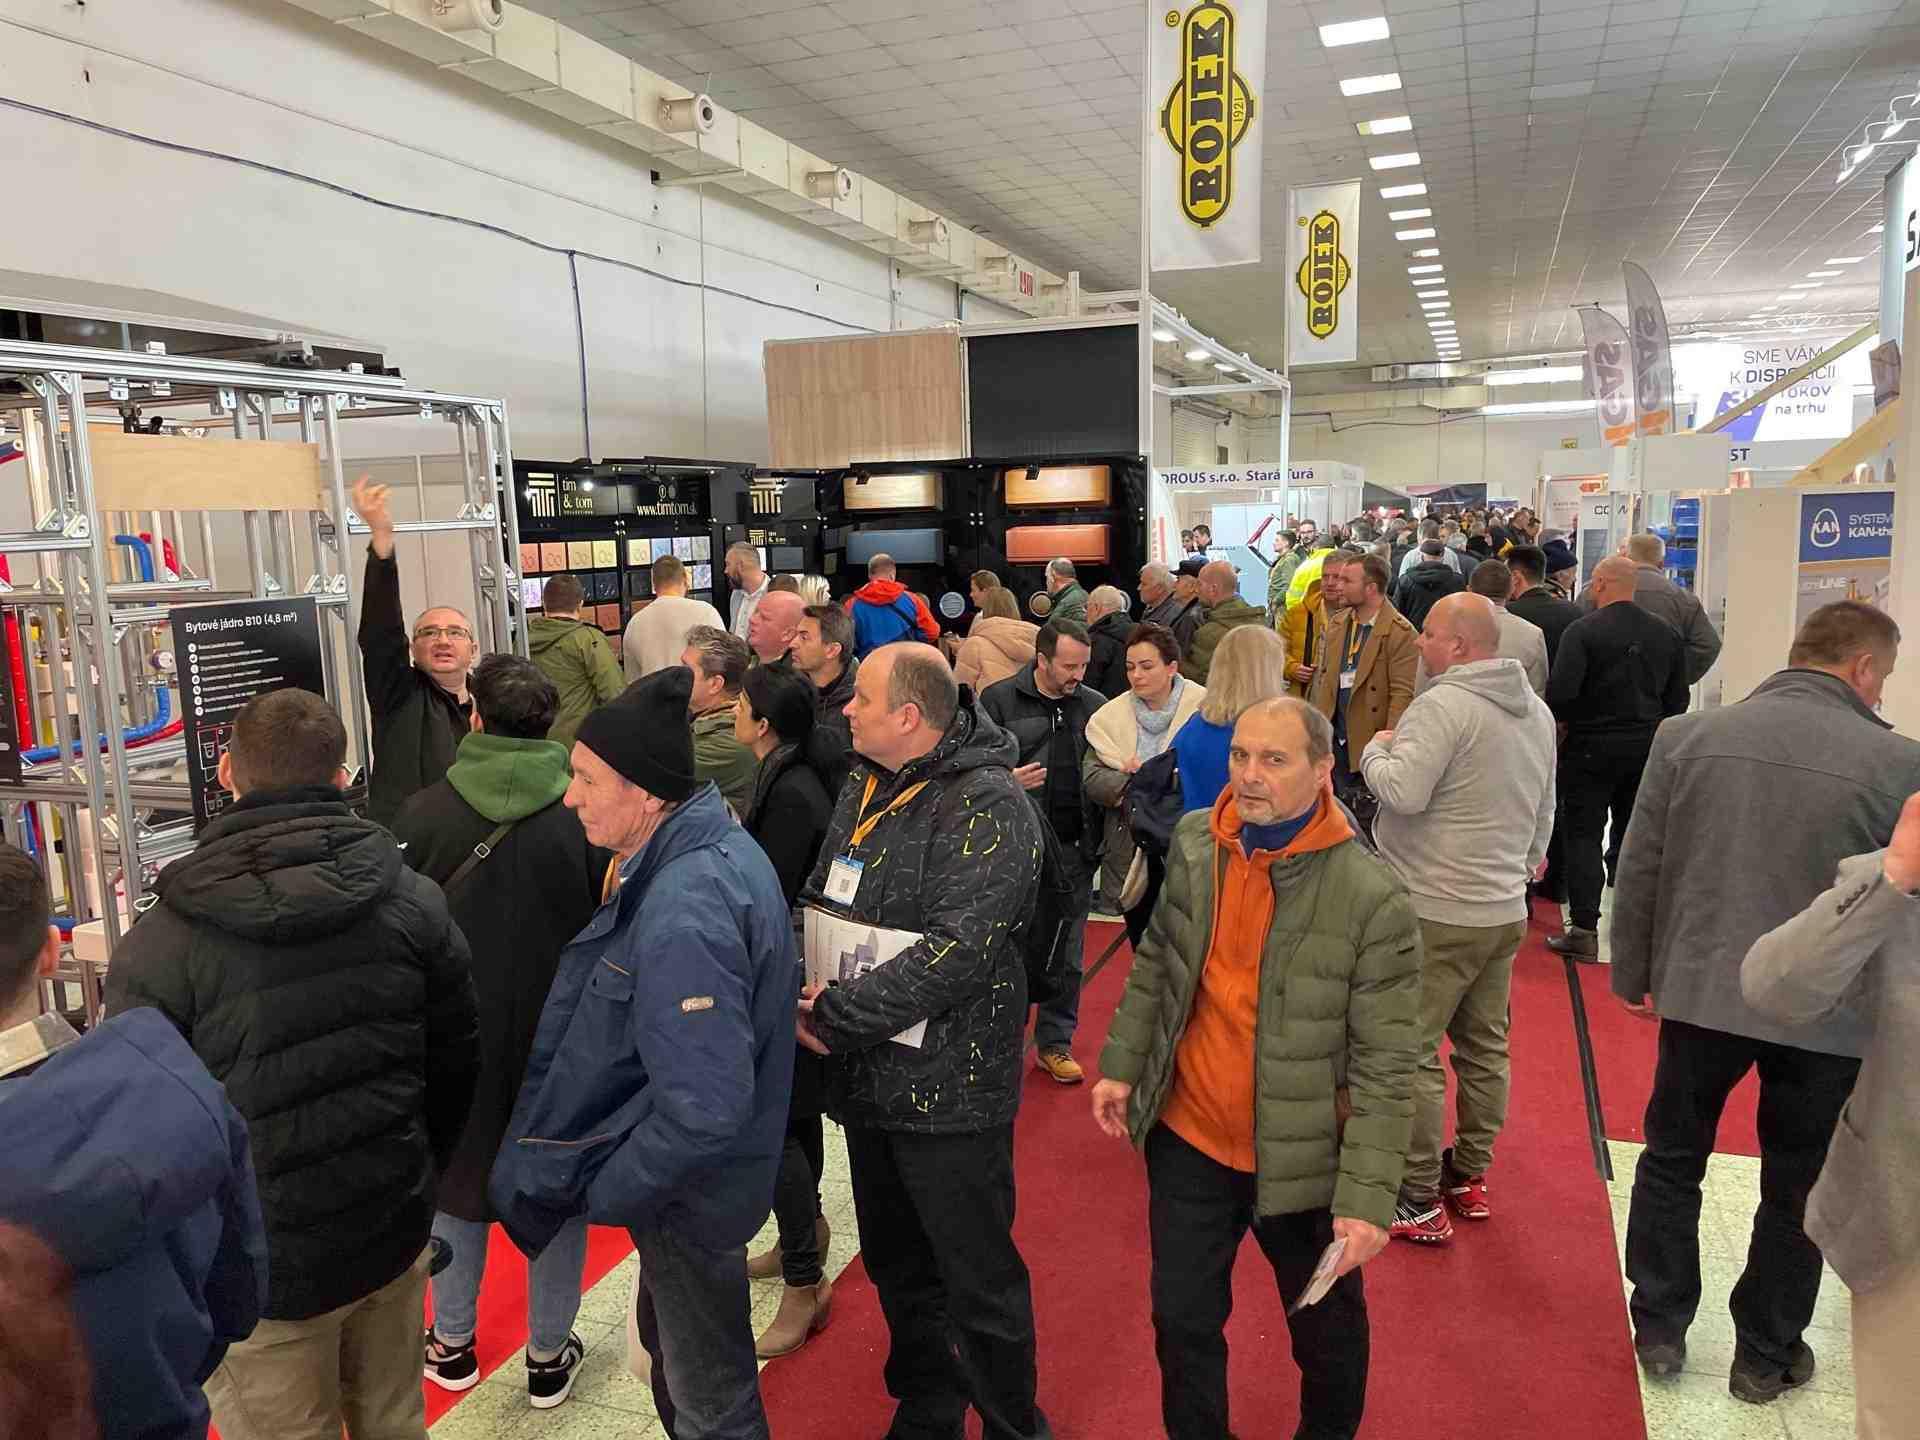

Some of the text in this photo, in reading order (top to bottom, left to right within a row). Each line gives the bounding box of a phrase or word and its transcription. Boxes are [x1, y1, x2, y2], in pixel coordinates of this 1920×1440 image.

[1190, 17, 1225, 206] ROJEK
[1233, 98, 1244, 122] 1921
[1313, 221, 1334, 328] ROJEK
[1743, 348, 1781, 364] SME
[1730, 371, 1742, 385] K
[1775, 402, 1826, 415] na trhu
[1209, 472, 1240, 483] s.r.o.
[1246, 468, 1280, 482] Stará
[562, 477, 577, 491] tim
[562, 494, 593, 508] & tom
[1813, 520, 1840, 533] KAN
[185, 619, 219, 634] Bytové
[220, 617, 244, 631] jádro
[245, 615, 262, 627] B10
